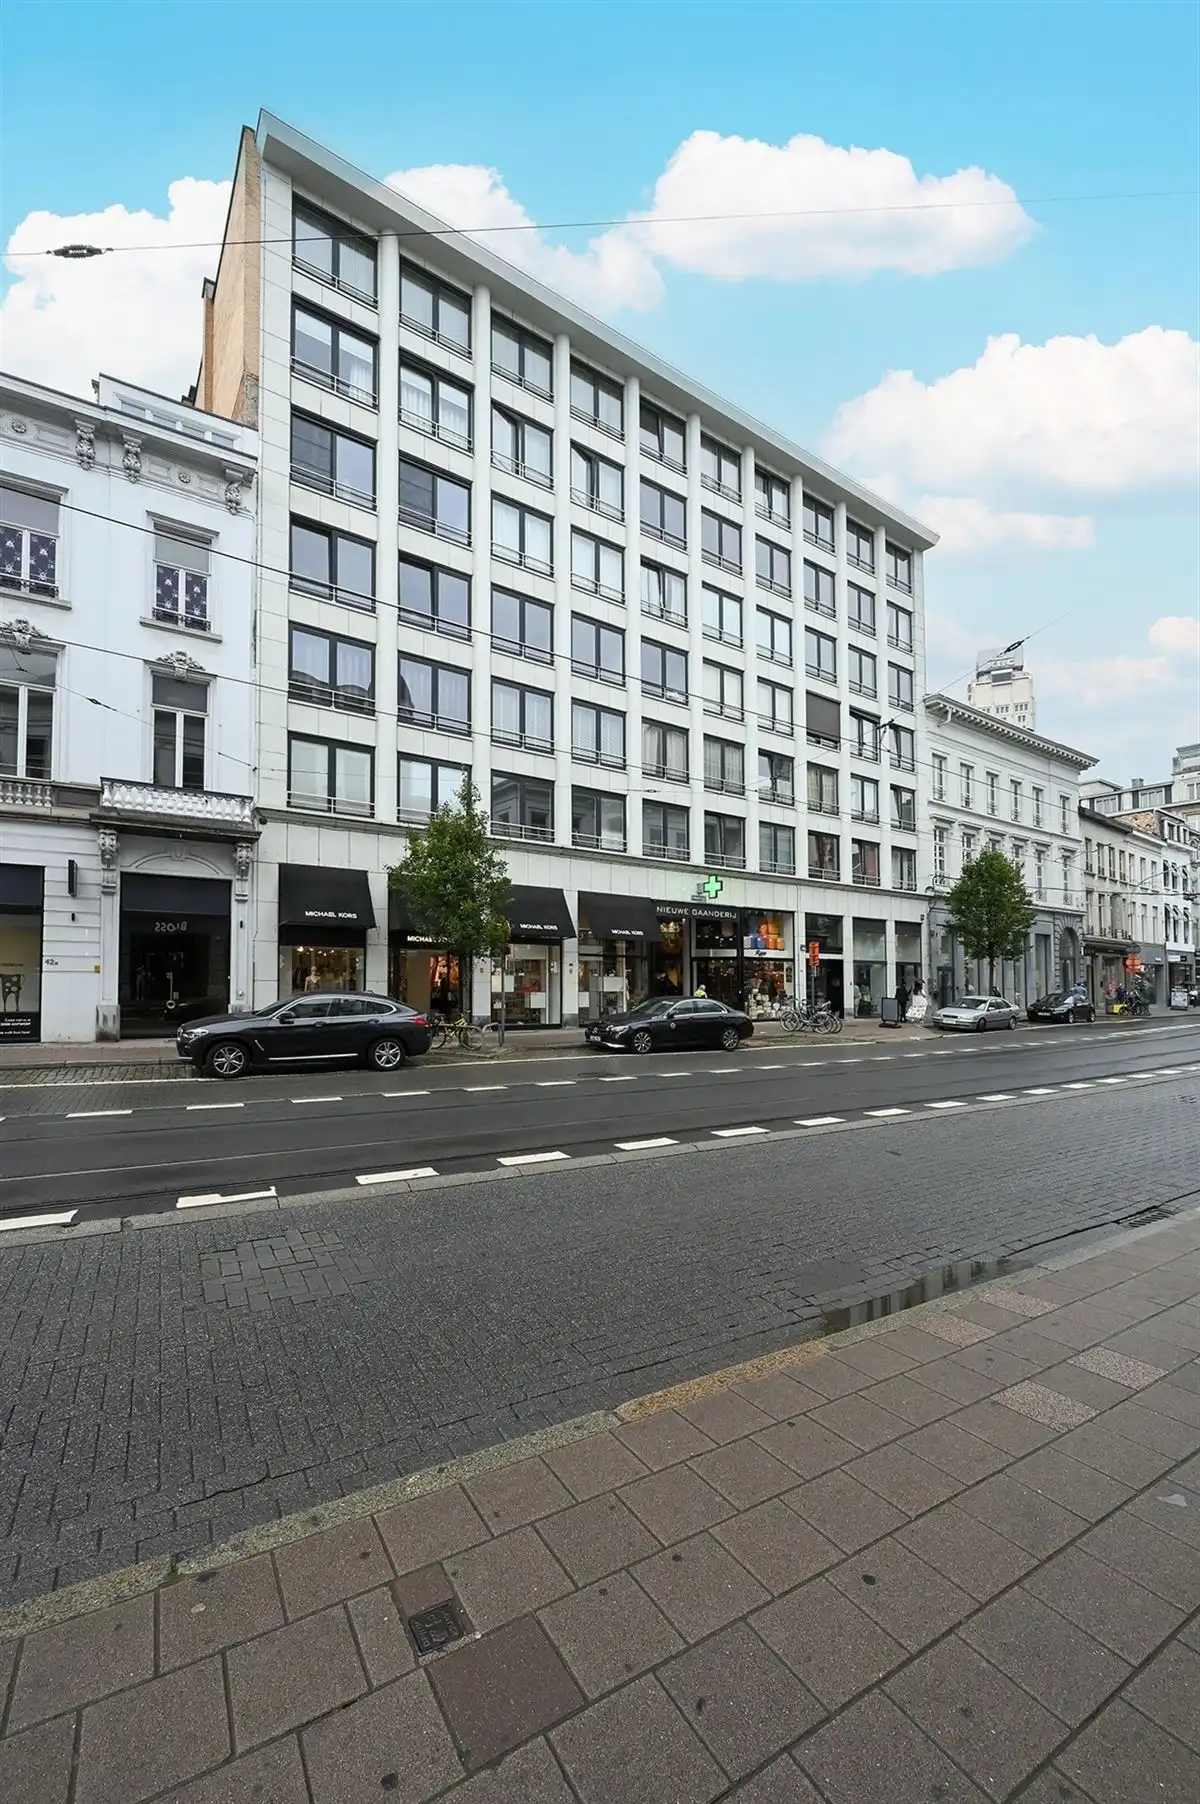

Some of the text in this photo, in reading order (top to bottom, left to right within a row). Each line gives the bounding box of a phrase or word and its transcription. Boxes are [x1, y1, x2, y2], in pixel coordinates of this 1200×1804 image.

[304, 910, 337, 918] MICHAEL
[656, 906, 737, 919] NIEUWE GAANDERIJ
